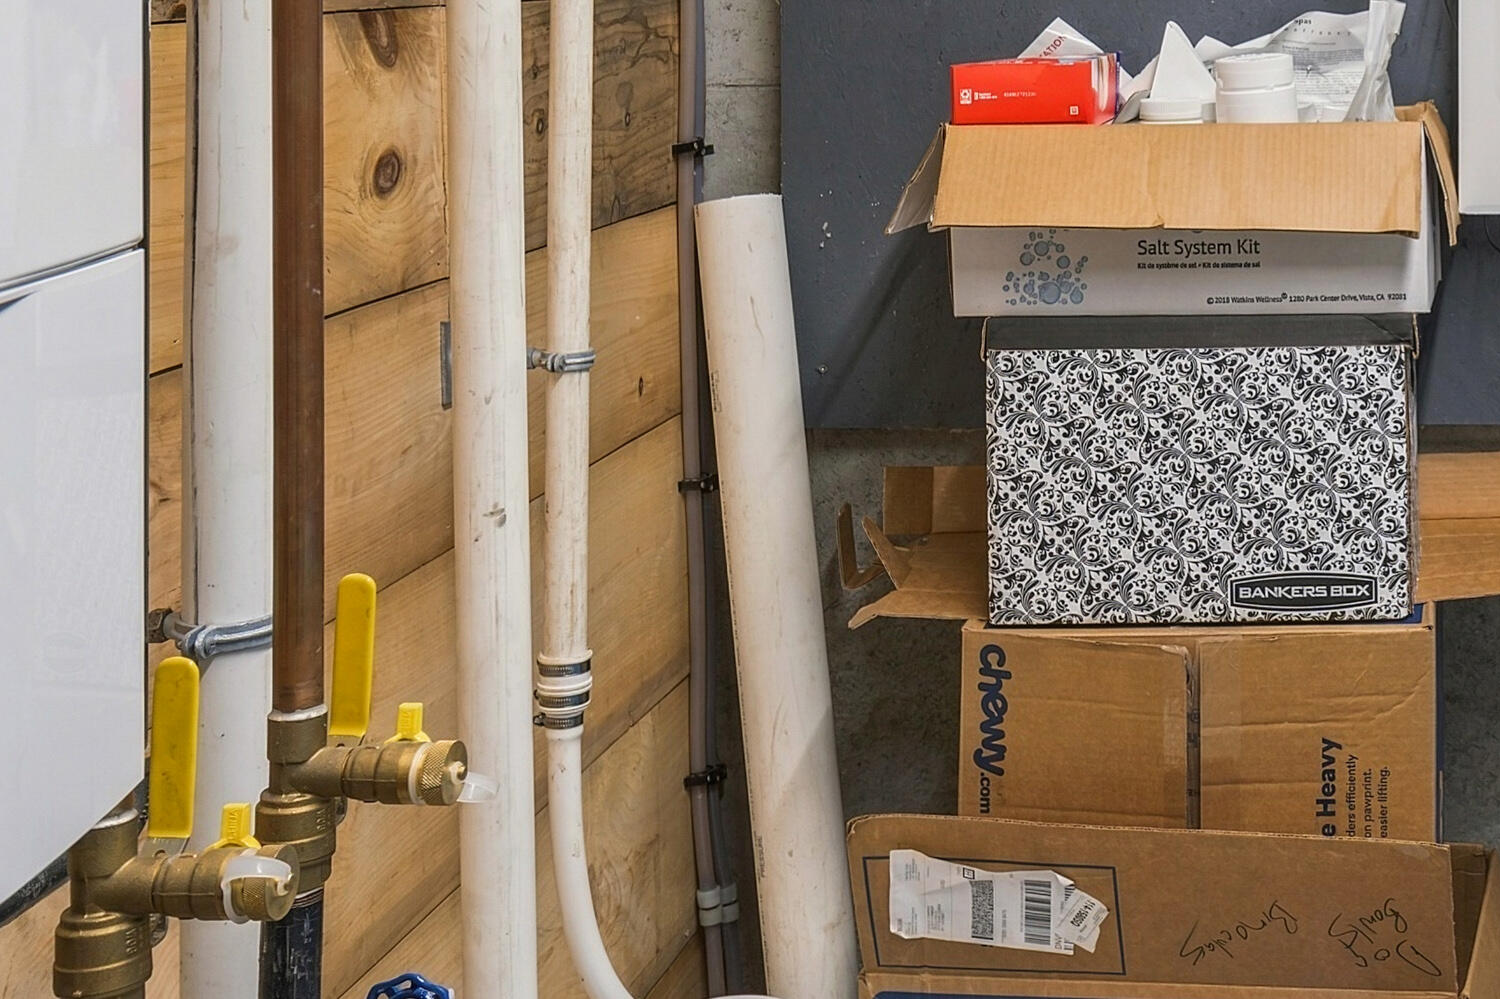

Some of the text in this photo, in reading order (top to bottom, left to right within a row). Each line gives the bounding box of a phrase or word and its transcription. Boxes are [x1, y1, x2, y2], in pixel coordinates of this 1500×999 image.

[1137, 239, 1260, 258] Salt System Kit
[1202, 261, 1212, 269] Kit
[1305, 294, 1319, 302] Park
[1376, 293, 1385, 301] CA
[1239, 585, 1370, 599] BANKERS BOX
[1316, 737, 1342, 817] Heavy
[1345, 754, 1359, 811] efficiently
[1362, 768, 1374, 838] on pawprint.
[1377, 766, 1391, 838] easier lifting.
[1338, 939, 1442, 977] Dog
